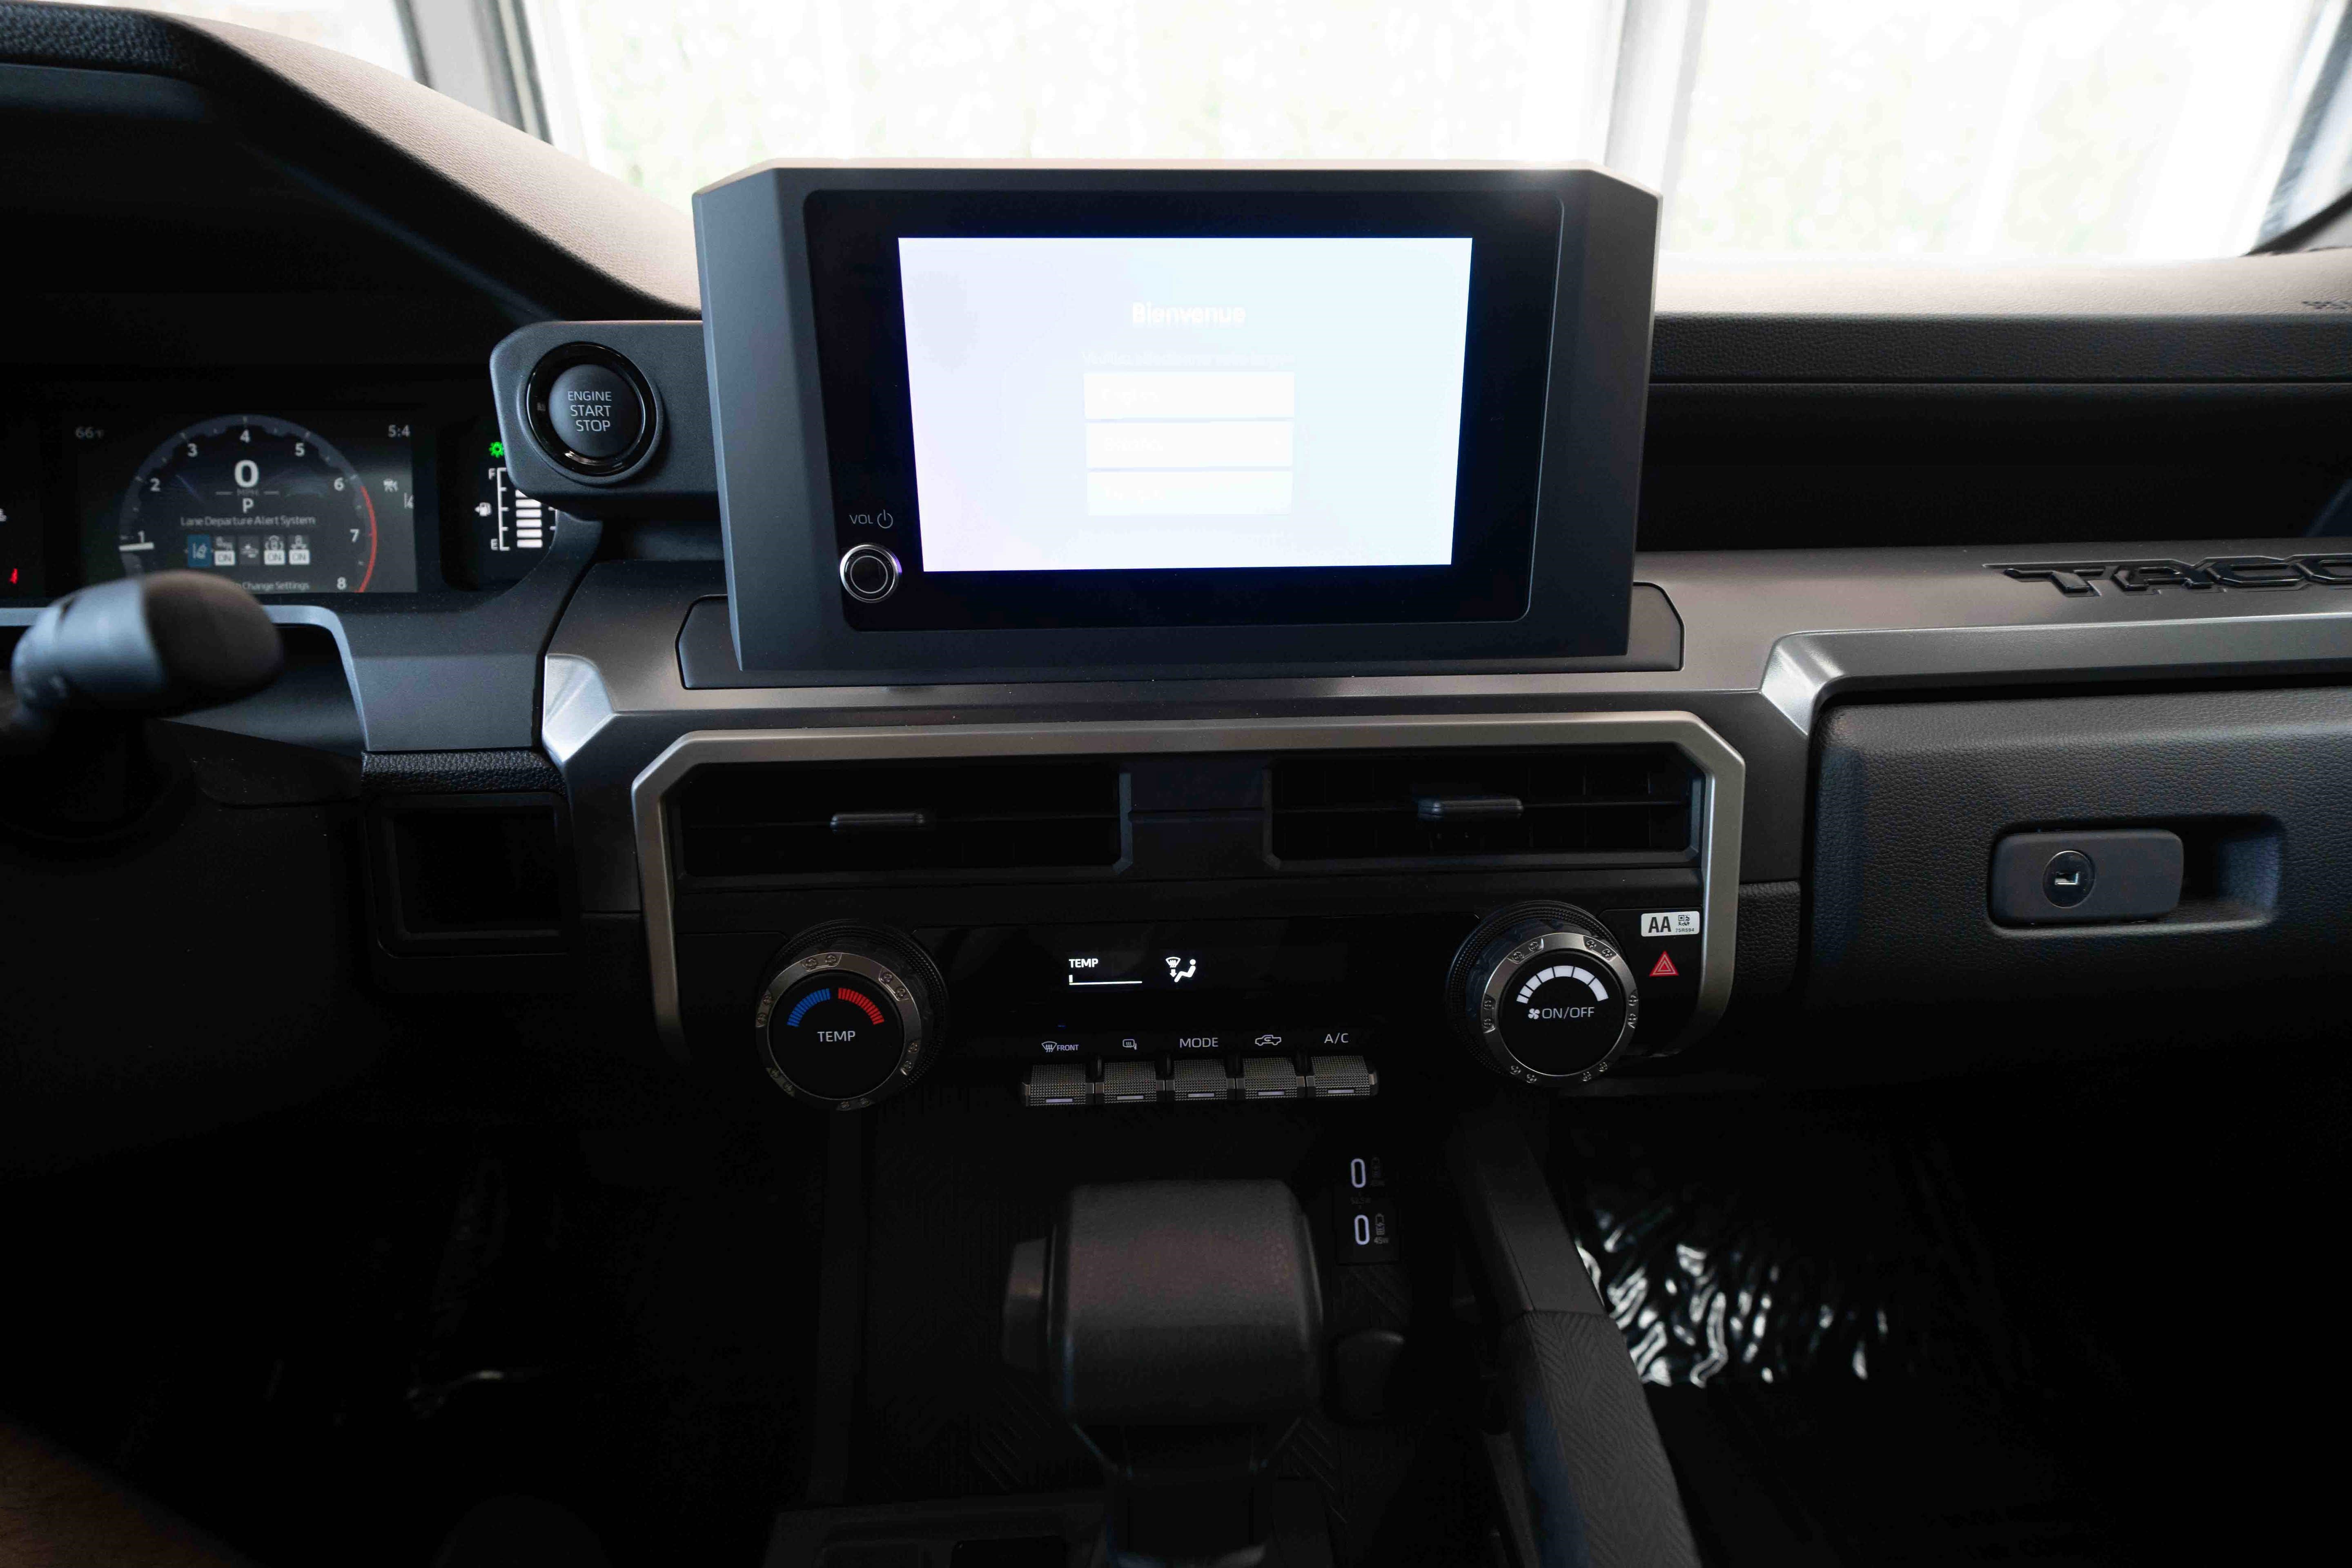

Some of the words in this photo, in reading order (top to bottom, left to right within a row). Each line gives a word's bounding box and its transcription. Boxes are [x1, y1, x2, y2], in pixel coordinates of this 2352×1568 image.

[1133, 302, 1246, 323] Bienvenue
[568, 391, 612, 401] ENGINE
[570, 405, 611, 417] START
[575, 420, 610, 432] STOP
[240, 430, 250, 443] 4
[187, 443, 198, 457] 3
[295, 443, 305, 457] 5
[234, 460, 259, 488] 0
[489, 468, 495, 480] F
[150, 478, 160, 491] 2
[334, 478, 345, 491] 6
[243, 498, 254, 513] P
[180, 517, 204, 526] Lane
[205, 516, 254, 527] Departure
[254, 516, 279, 526] Alert
[281, 515, 316, 527] System
[849, 514, 873, 524] VOL
[137, 531, 145, 542] 1
[350, 529, 359, 542] 7
[491, 538, 499, 550] E
[242, 581, 274, 590] Change
[275, 581, 310, 590] Settings
[337, 577, 347, 590] 8
[1648, 916, 1672, 933] AA
[1069, 958, 1098, 968] TEMP
[1542, 1007, 1595, 1019] ON/OFF
[817, 1031, 855, 1042] TEMP
[1324, 1033, 1348, 1044] A/C
[1180, 1038, 1219, 1048] MODE
